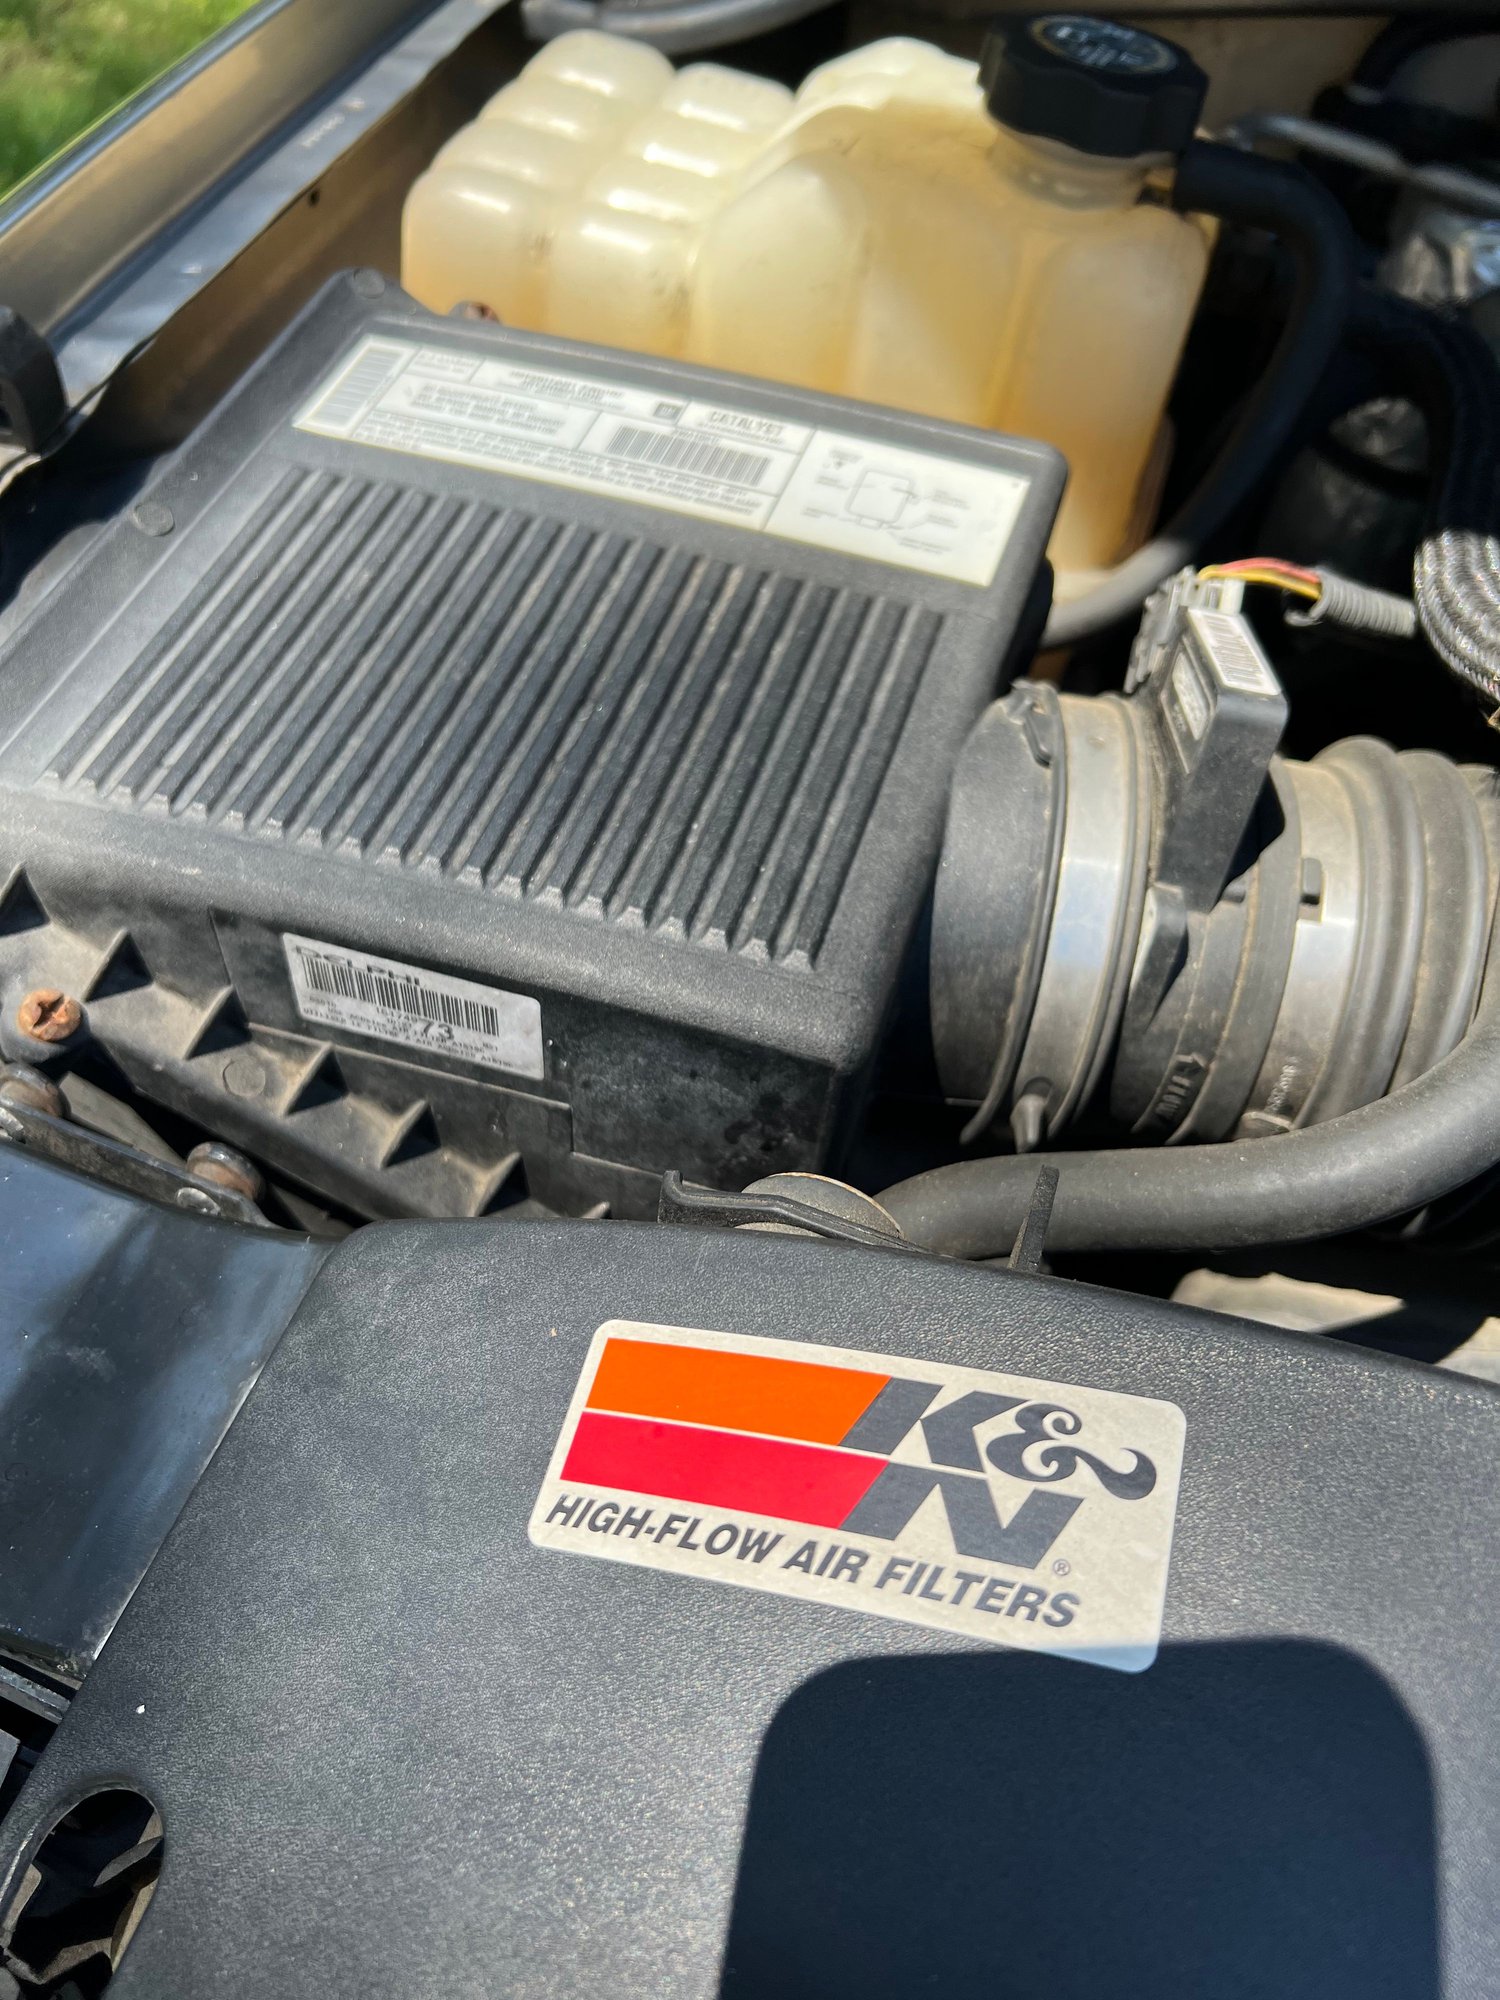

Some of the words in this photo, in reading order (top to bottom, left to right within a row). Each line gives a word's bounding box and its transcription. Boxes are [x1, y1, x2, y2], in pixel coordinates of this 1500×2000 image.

[295, 945, 420, 986] DELPHI
[838, 1376, 1157, 1570] K&N
[544, 1493, 785, 1564] HIGH-FLOW
[781, 1540, 870, 1583] AIR
[873, 1556, 1081, 1628] FILTERS
